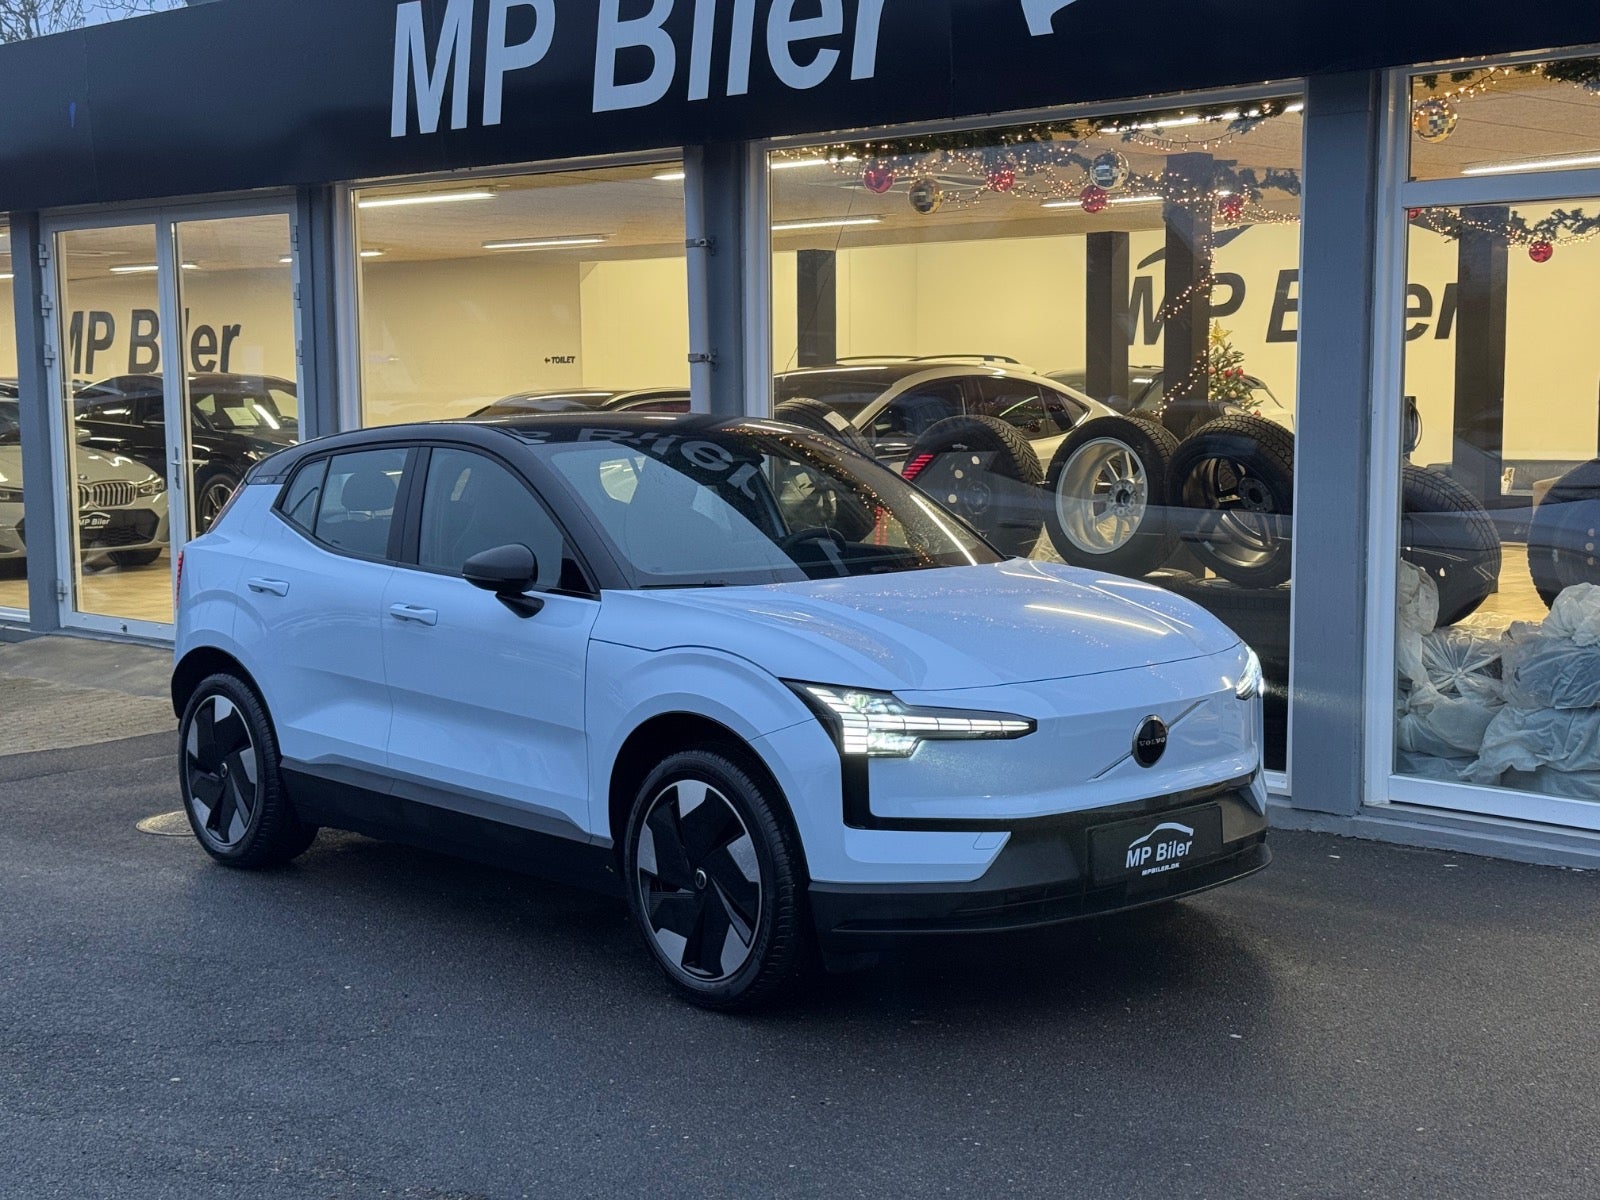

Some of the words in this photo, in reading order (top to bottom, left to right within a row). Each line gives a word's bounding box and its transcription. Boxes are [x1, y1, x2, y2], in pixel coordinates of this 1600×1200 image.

[391, 0, 556, 138] MP
[551, 356, 576, 364] TOILET
[1140, 737, 1166, 747] VOLVO
[1125, 846, 1152, 869] MP
[1155, 840, 1193, 862] Biler
[1141, 862, 1180, 877] MPBILER.DK
